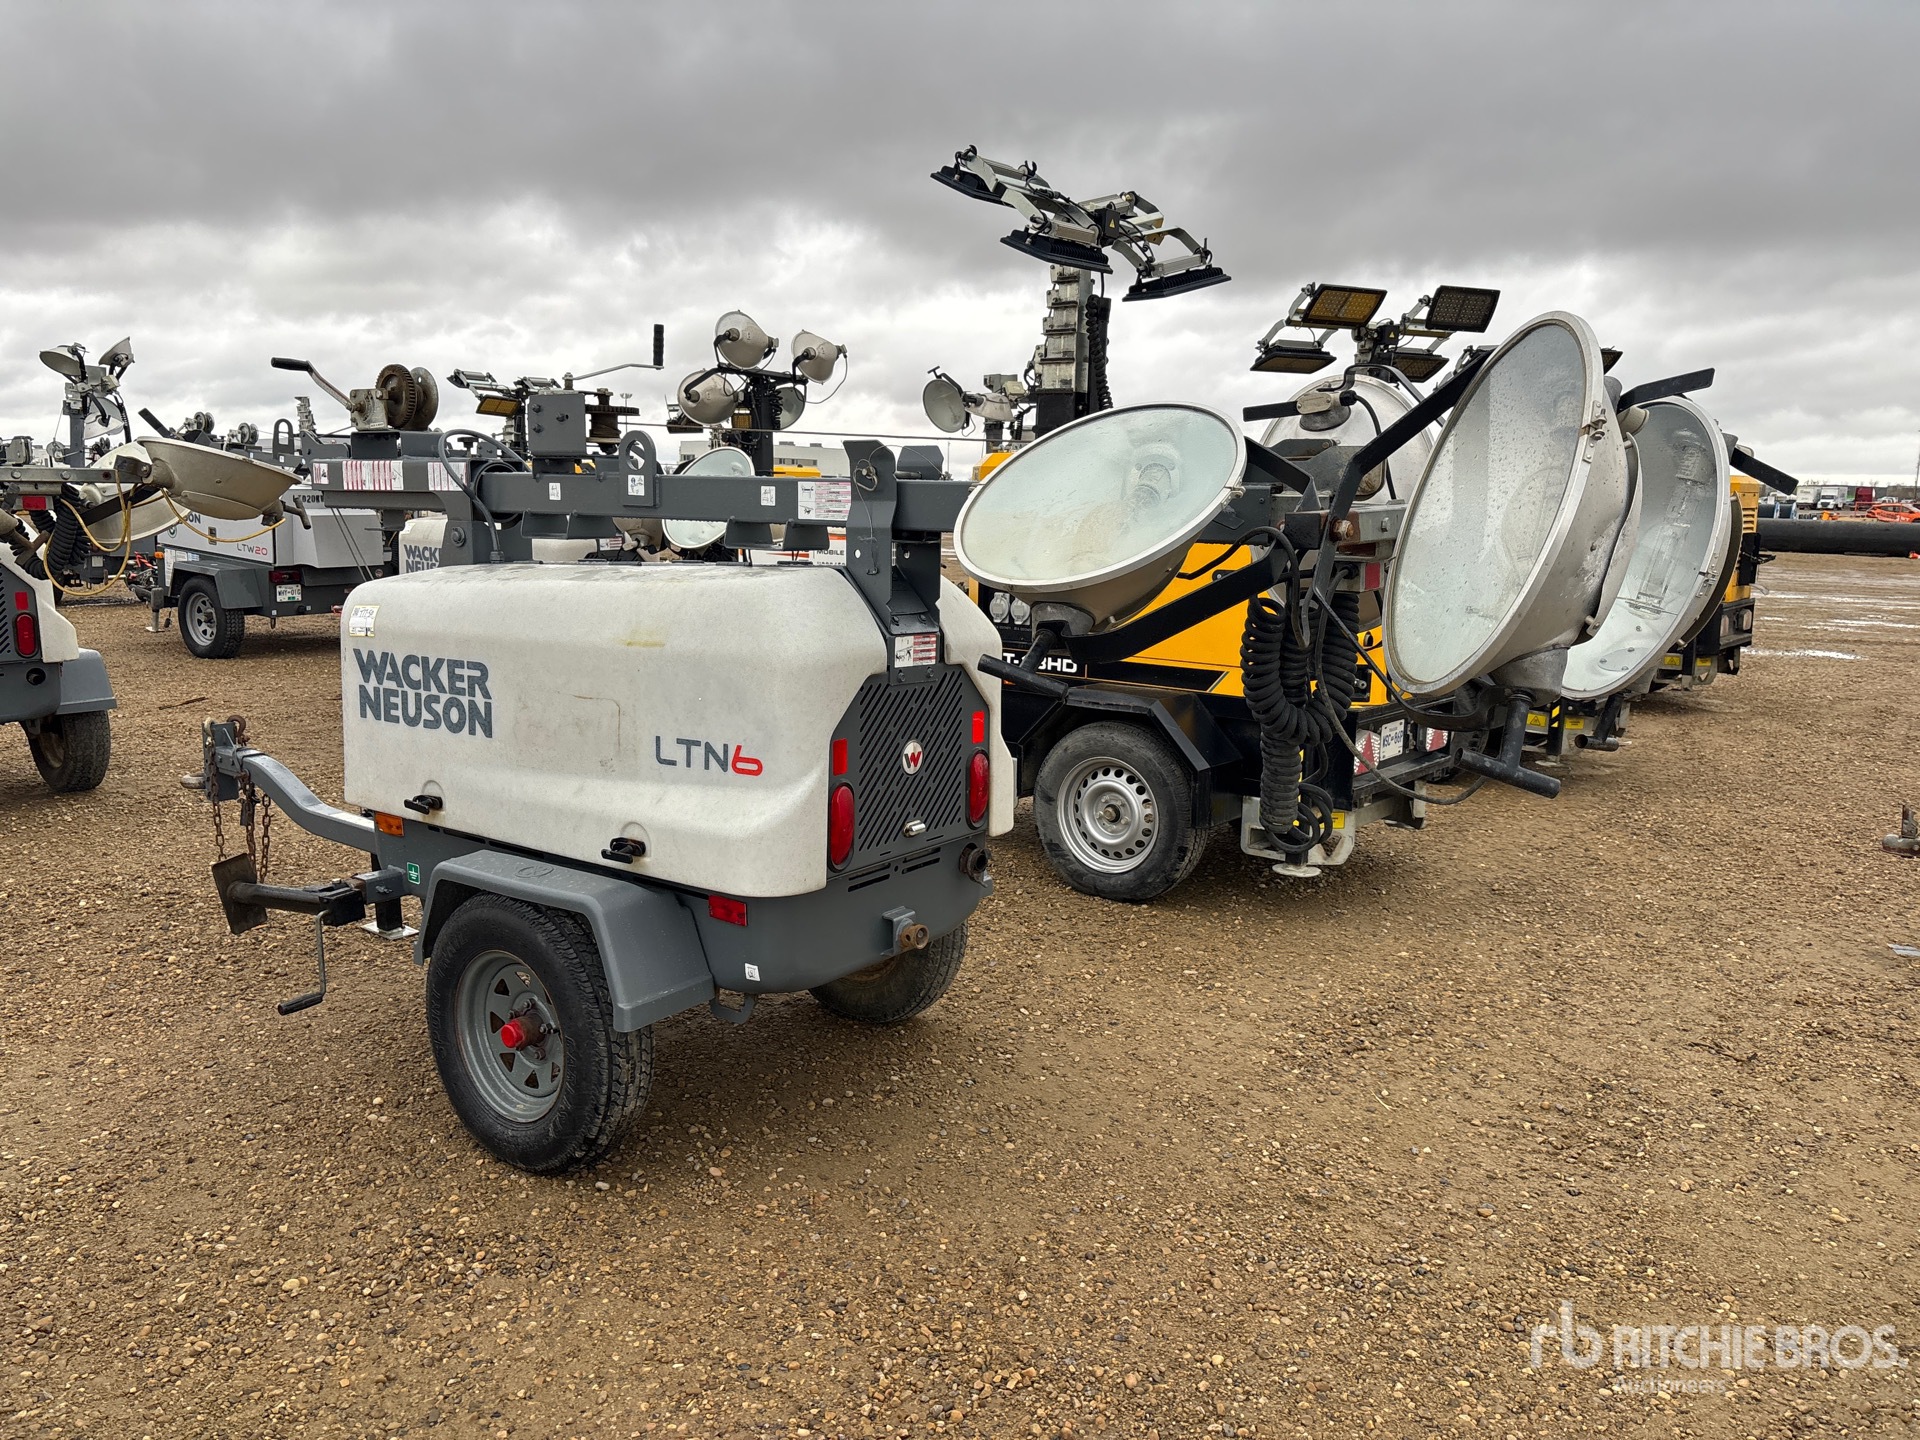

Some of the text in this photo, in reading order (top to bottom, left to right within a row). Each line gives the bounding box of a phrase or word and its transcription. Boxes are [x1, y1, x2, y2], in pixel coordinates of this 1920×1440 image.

[237, 543, 268, 556] LTW20
[352, 648, 492, 700] WACKER
[358, 684, 493, 739] NEUSON
[655, 735, 763, 776] LTN6
